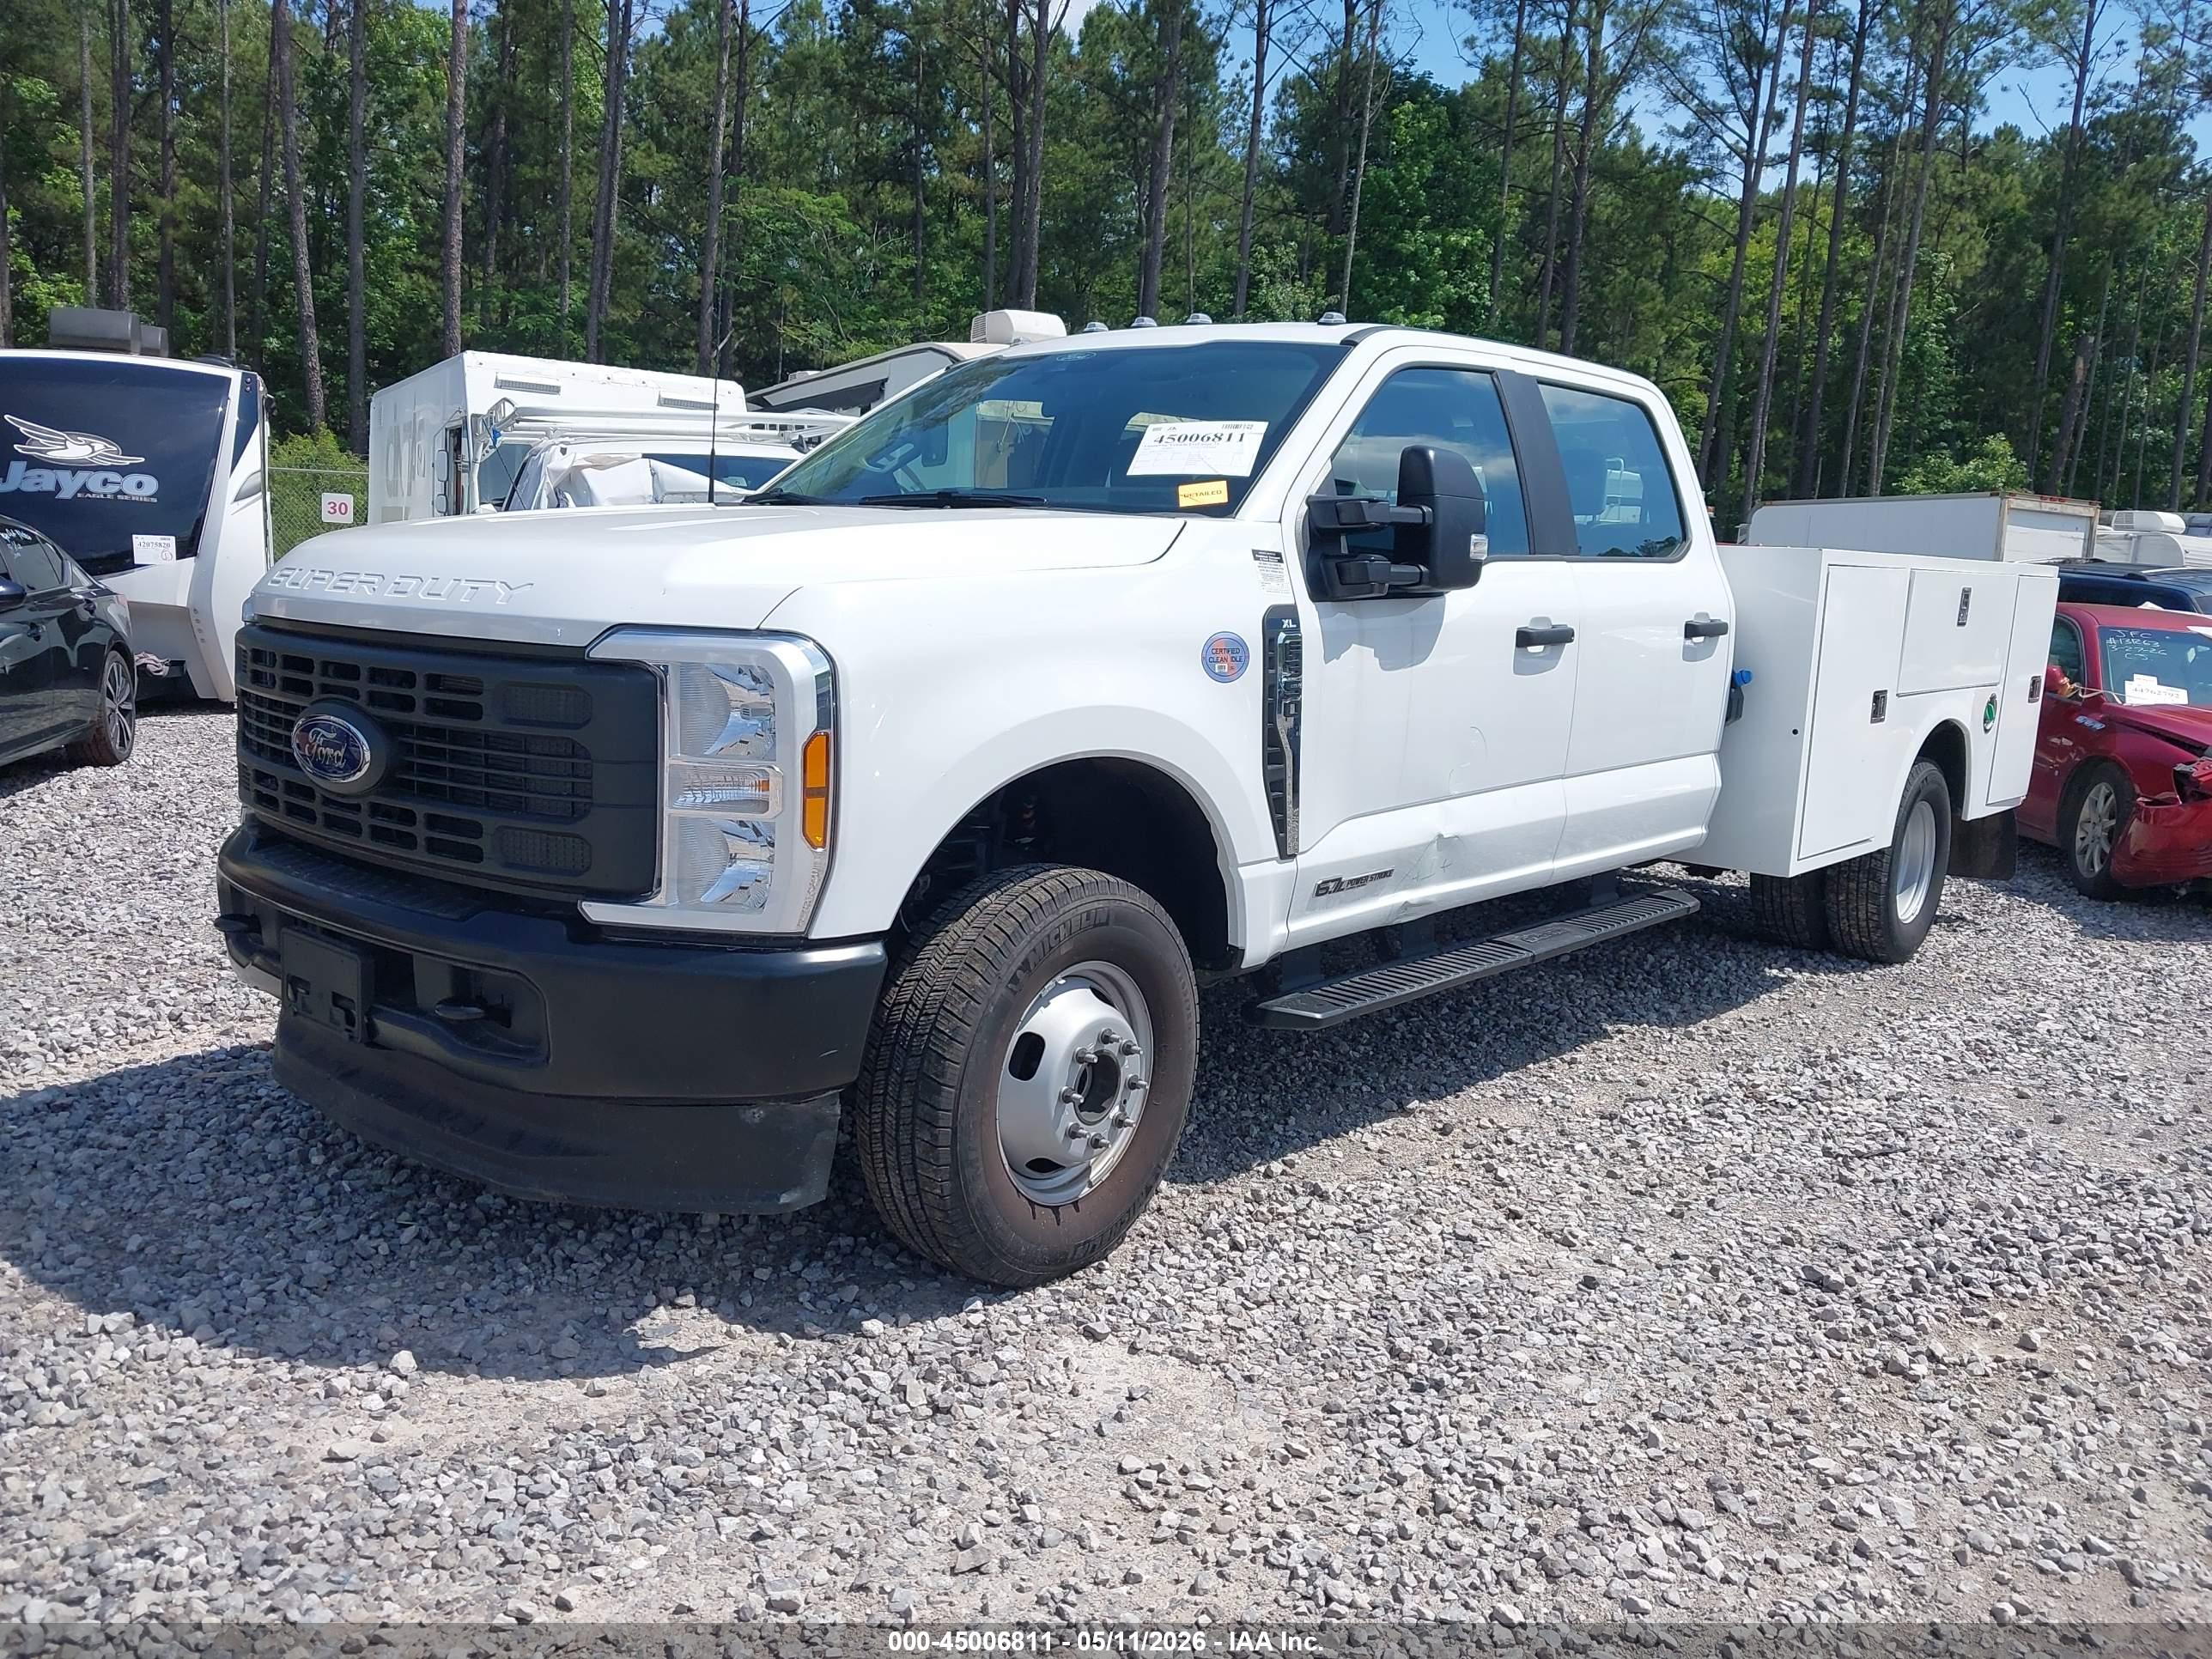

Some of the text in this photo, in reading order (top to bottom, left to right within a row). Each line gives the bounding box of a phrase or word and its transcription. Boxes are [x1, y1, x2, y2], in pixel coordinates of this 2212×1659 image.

[1154, 432, 1246, 444] 45006811
[0, 460, 159, 500] Jayco
[116, 494, 158, 503] SERIES
[327, 501, 349, 515] 30
[268, 567, 535, 605] SUPER DUTY
[1282, 618, 1297, 629] XL
[305, 727, 348, 769] Ford
[1346, 875, 1370, 888] POWER
[1369, 868, 1395, 882] STROKE
[1030, 907, 1110, 972] MICHELIN
